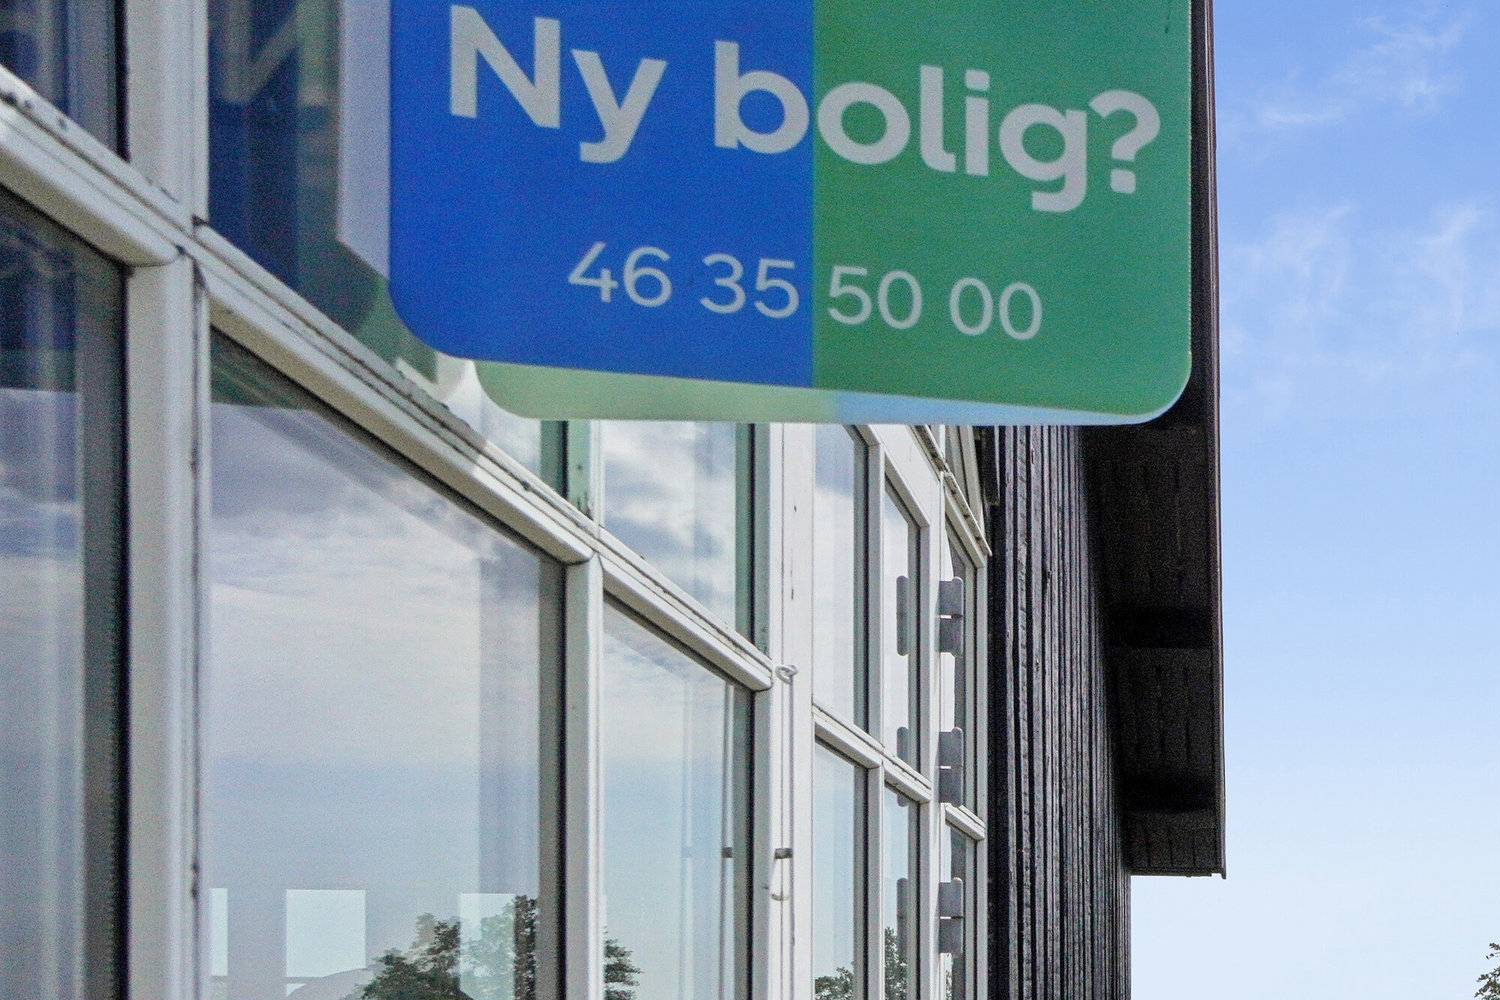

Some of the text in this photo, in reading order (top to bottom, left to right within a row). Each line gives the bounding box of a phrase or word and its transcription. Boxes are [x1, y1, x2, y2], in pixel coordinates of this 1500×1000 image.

[449, 4, 667, 164] Ny
[714, 41, 1161, 213] bolig?
[568, 242, 1043, 341] 46 35 50 00
